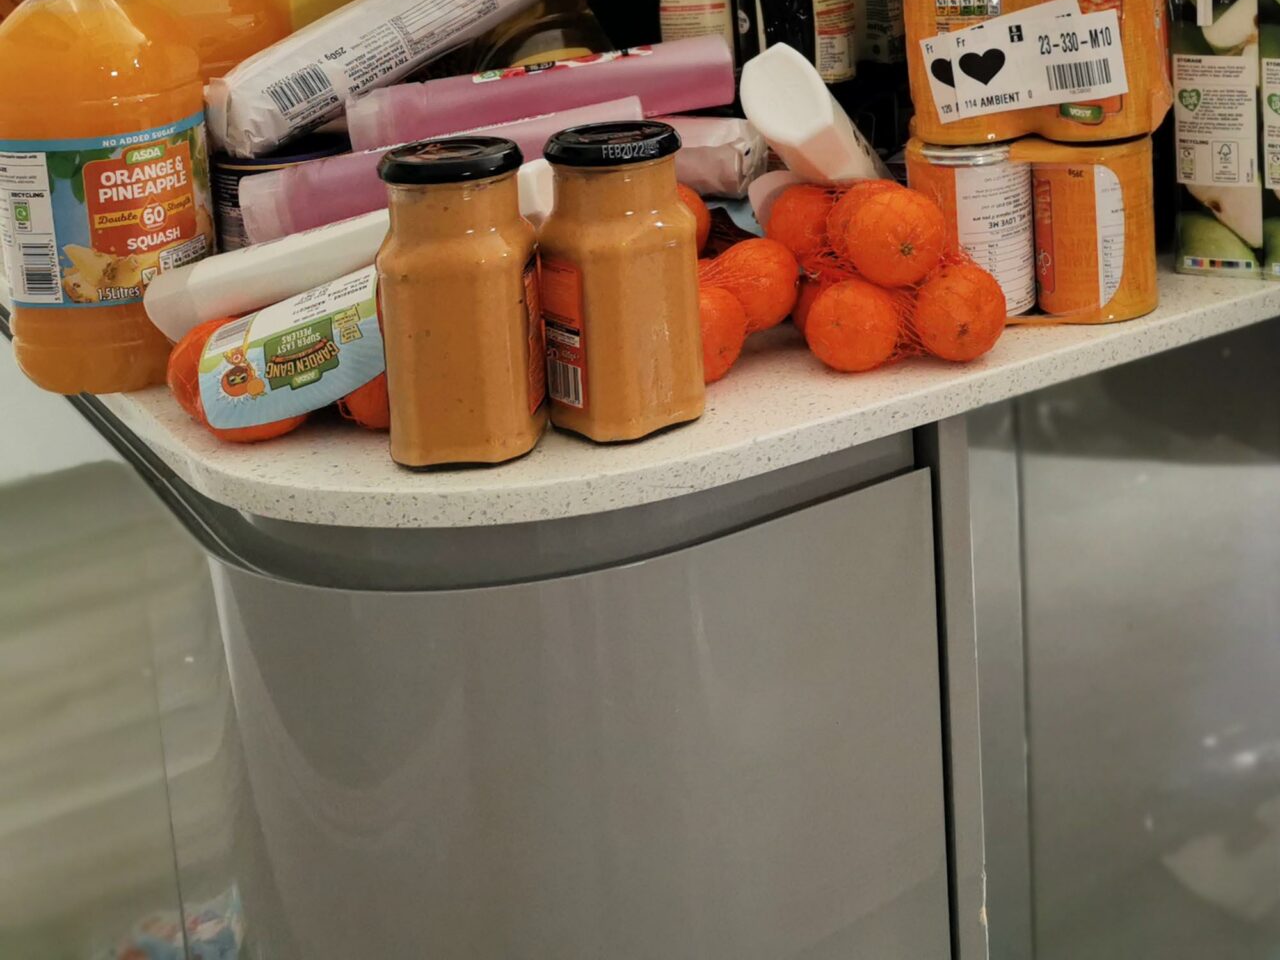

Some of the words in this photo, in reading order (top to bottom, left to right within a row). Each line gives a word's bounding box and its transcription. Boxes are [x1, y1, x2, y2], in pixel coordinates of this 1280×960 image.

[324, 47, 347, 61] 250g
[360, 72, 379, 85] LOVE
[980, 91, 1020, 108] AMBIENT
[102, 138, 117, 148] NO
[119, 134, 150, 146] ADDED
[132, 147, 161, 161] ASDA
[101, 161, 173, 186] ORANGE
[99, 171, 186, 203] PINEAPPLE
[143, 206, 164, 224] 60
[127, 227, 180, 250] SQUASH
[282, 326, 312, 344] PEELERS
[297, 333, 321, 347] SUPER
[296, 342, 339, 373] GARDEN
[266, 360, 295, 378] GANG
